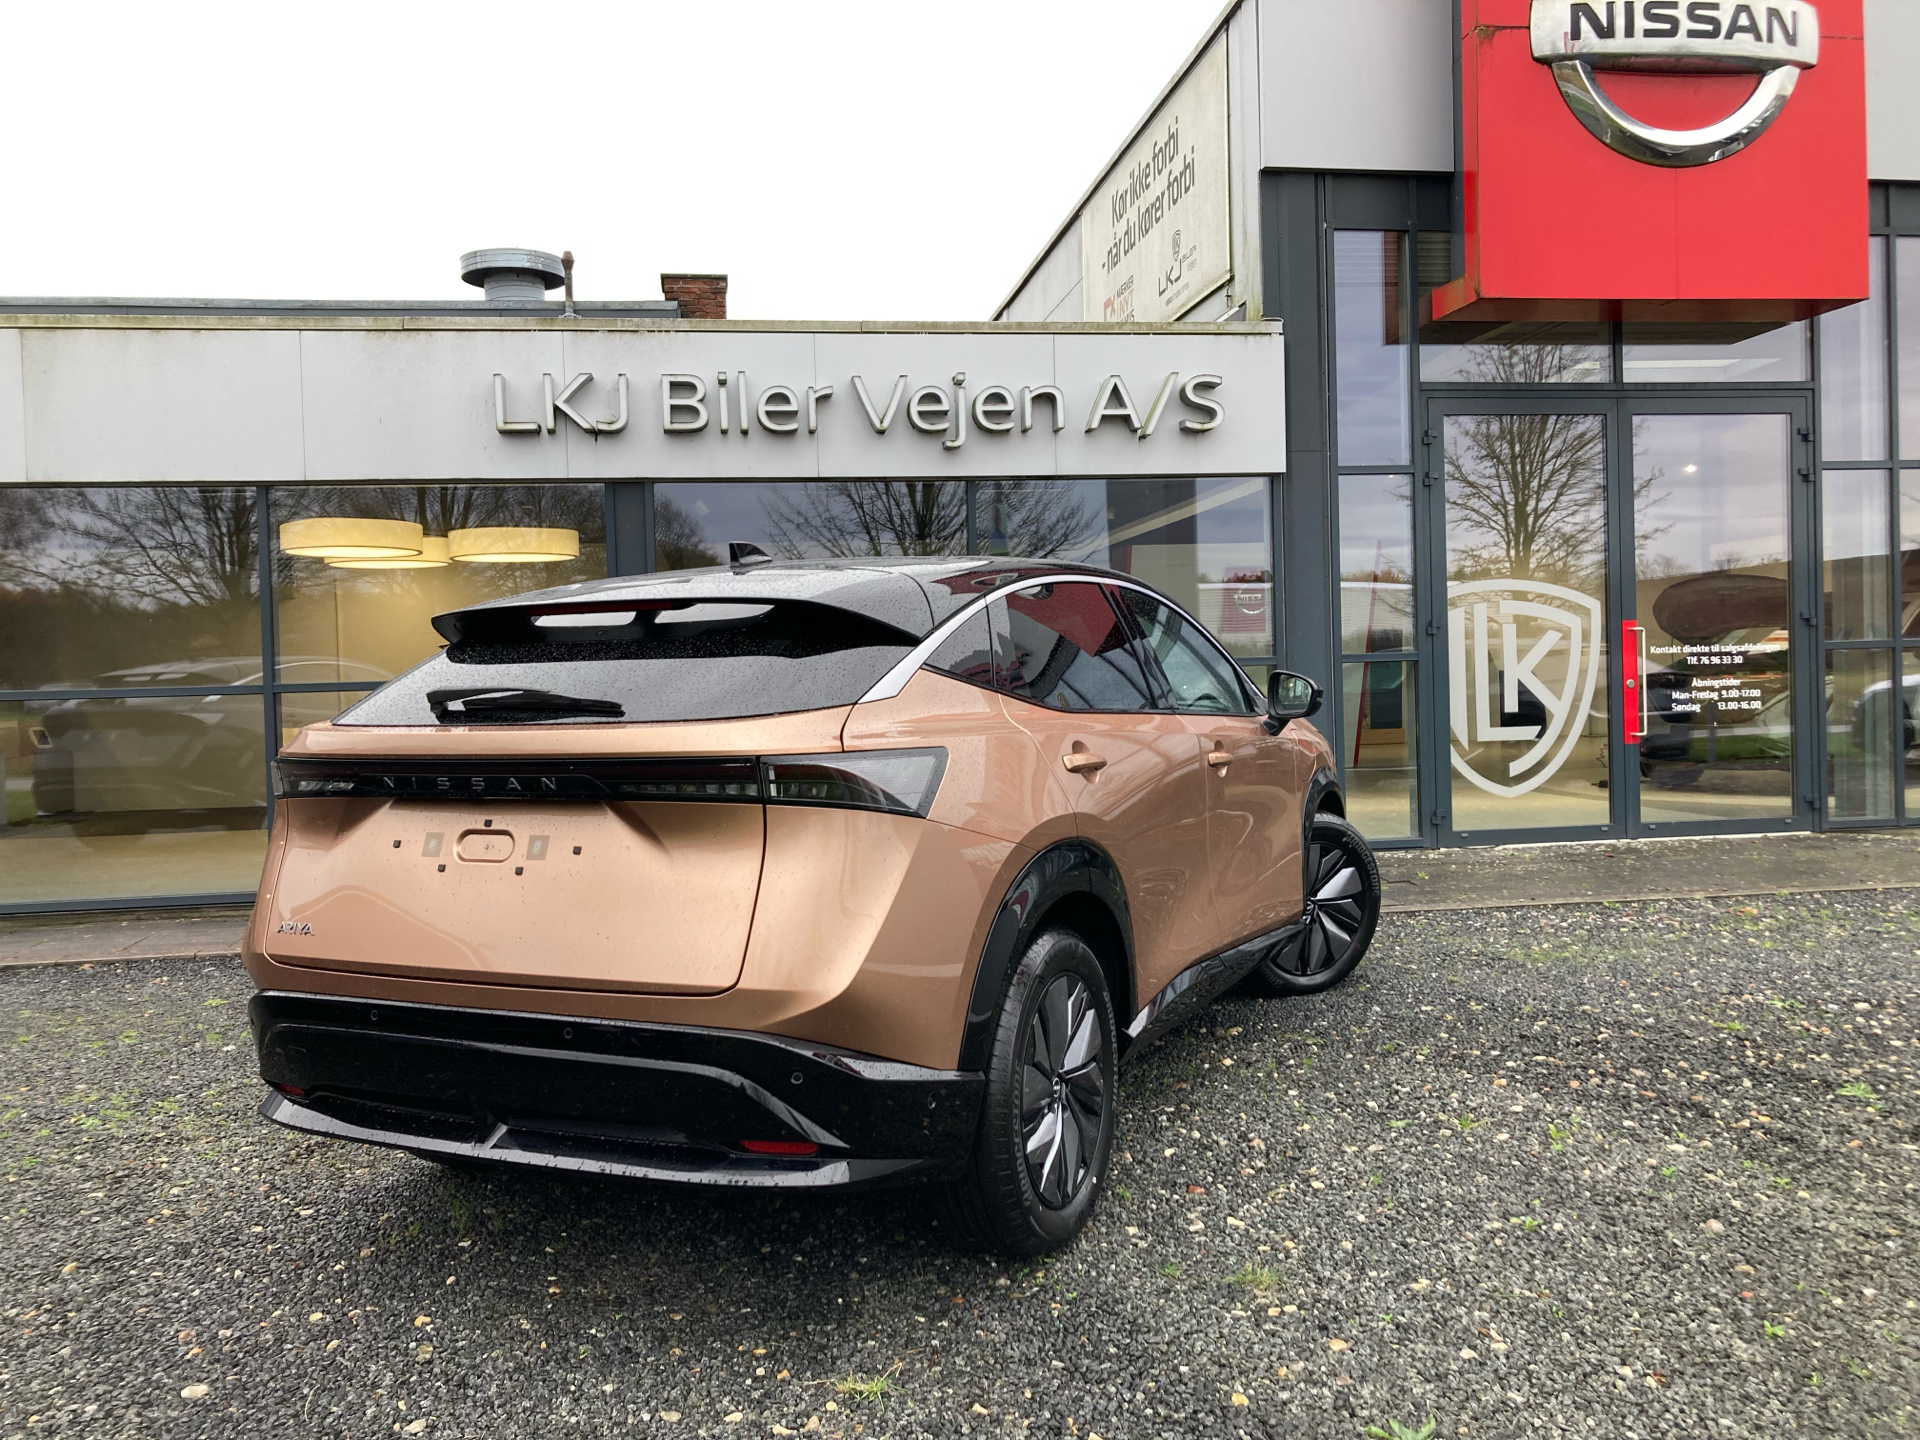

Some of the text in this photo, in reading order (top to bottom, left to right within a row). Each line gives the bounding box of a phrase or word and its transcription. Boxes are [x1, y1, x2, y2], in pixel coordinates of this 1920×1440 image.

[1569, 0, 1798, 48] NISSAN
[1111, 115, 1178, 228] Kør ikke forbi
[1123, 217, 1136, 257] du
[1137, 189, 1165, 242] kører
[1166, 145, 1195, 211] forbi
[1158, 257, 1182, 297] LKJ
[493, 370, 1226, 450] LKJ Biler Vejen A/S
[1650, 642, 1780, 654] Kontakt direkte til salgsafdelingen
[1686, 655, 1743, 665] Tlf. 76 96 33 30
[1691, 677, 1741, 688] Åbningstider
[1671, 689, 1761, 700] Man-Fredag 9.00-17.00
[1671, 701, 1761, 713] Søndag 13.00-16.00
[383, 776, 557, 791] NISSAN
[277, 921, 315, 936] ARIYA
